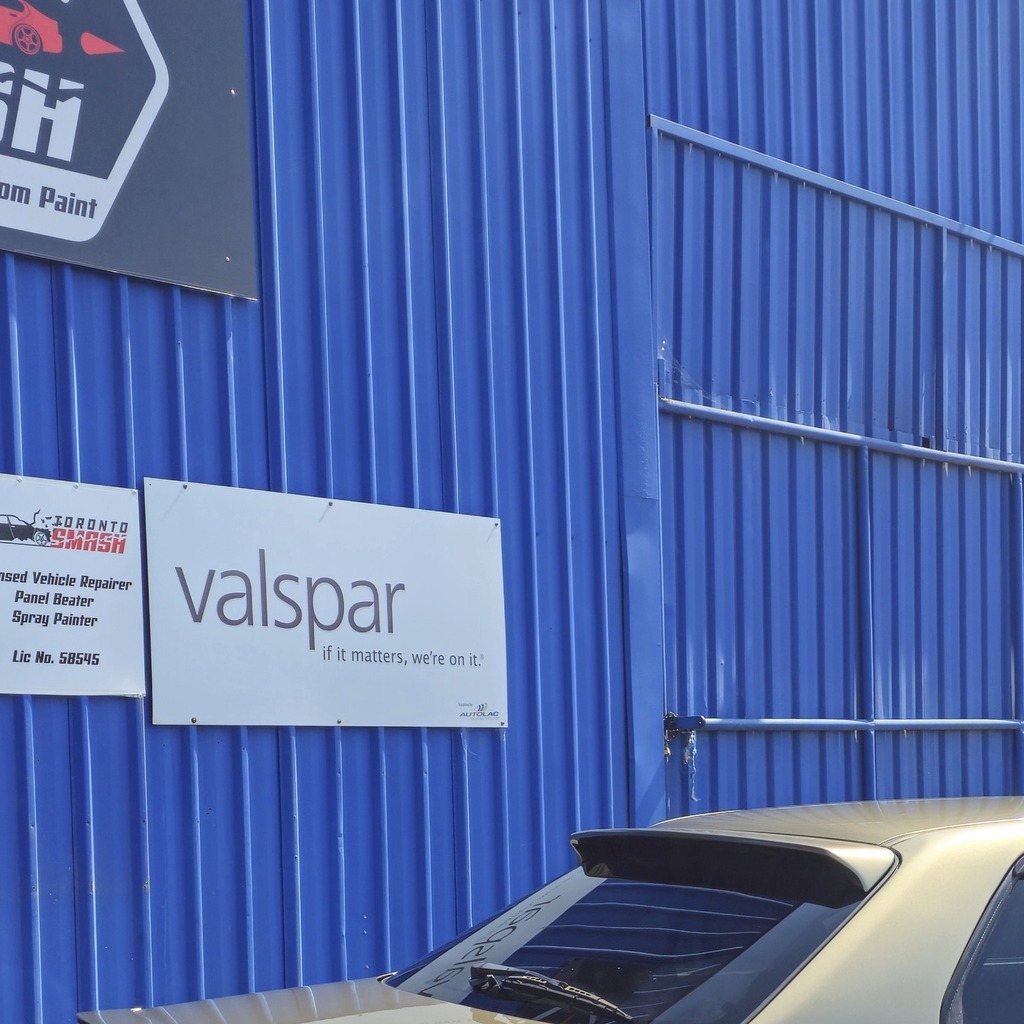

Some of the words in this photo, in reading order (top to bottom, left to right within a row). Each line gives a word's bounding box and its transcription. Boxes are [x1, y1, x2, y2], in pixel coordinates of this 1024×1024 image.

[39, 185, 97, 219] Paint
[54, 515, 128, 534] TORONTO
[51, 528, 128, 554] SMASH
[33, 571, 76, 587] Vehicle
[80, 575, 132, 591] Repairer
[14, 590, 50, 605] Panel
[53, 592, 94, 607] Beater
[175, 548, 405, 650] valspar
[12, 610, 49, 627] Spray
[53, 612, 98, 627] Painter
[12, 650, 31, 663] Lic
[35, 651, 54, 664] No.
[59, 651, 100, 666] 58545
[323, 645, 333, 661] if
[337, 646, 346, 662] it
[351, 649, 408, 666] matters,
[412, 651, 445, 665] we're
[449, 654, 465, 666] on
